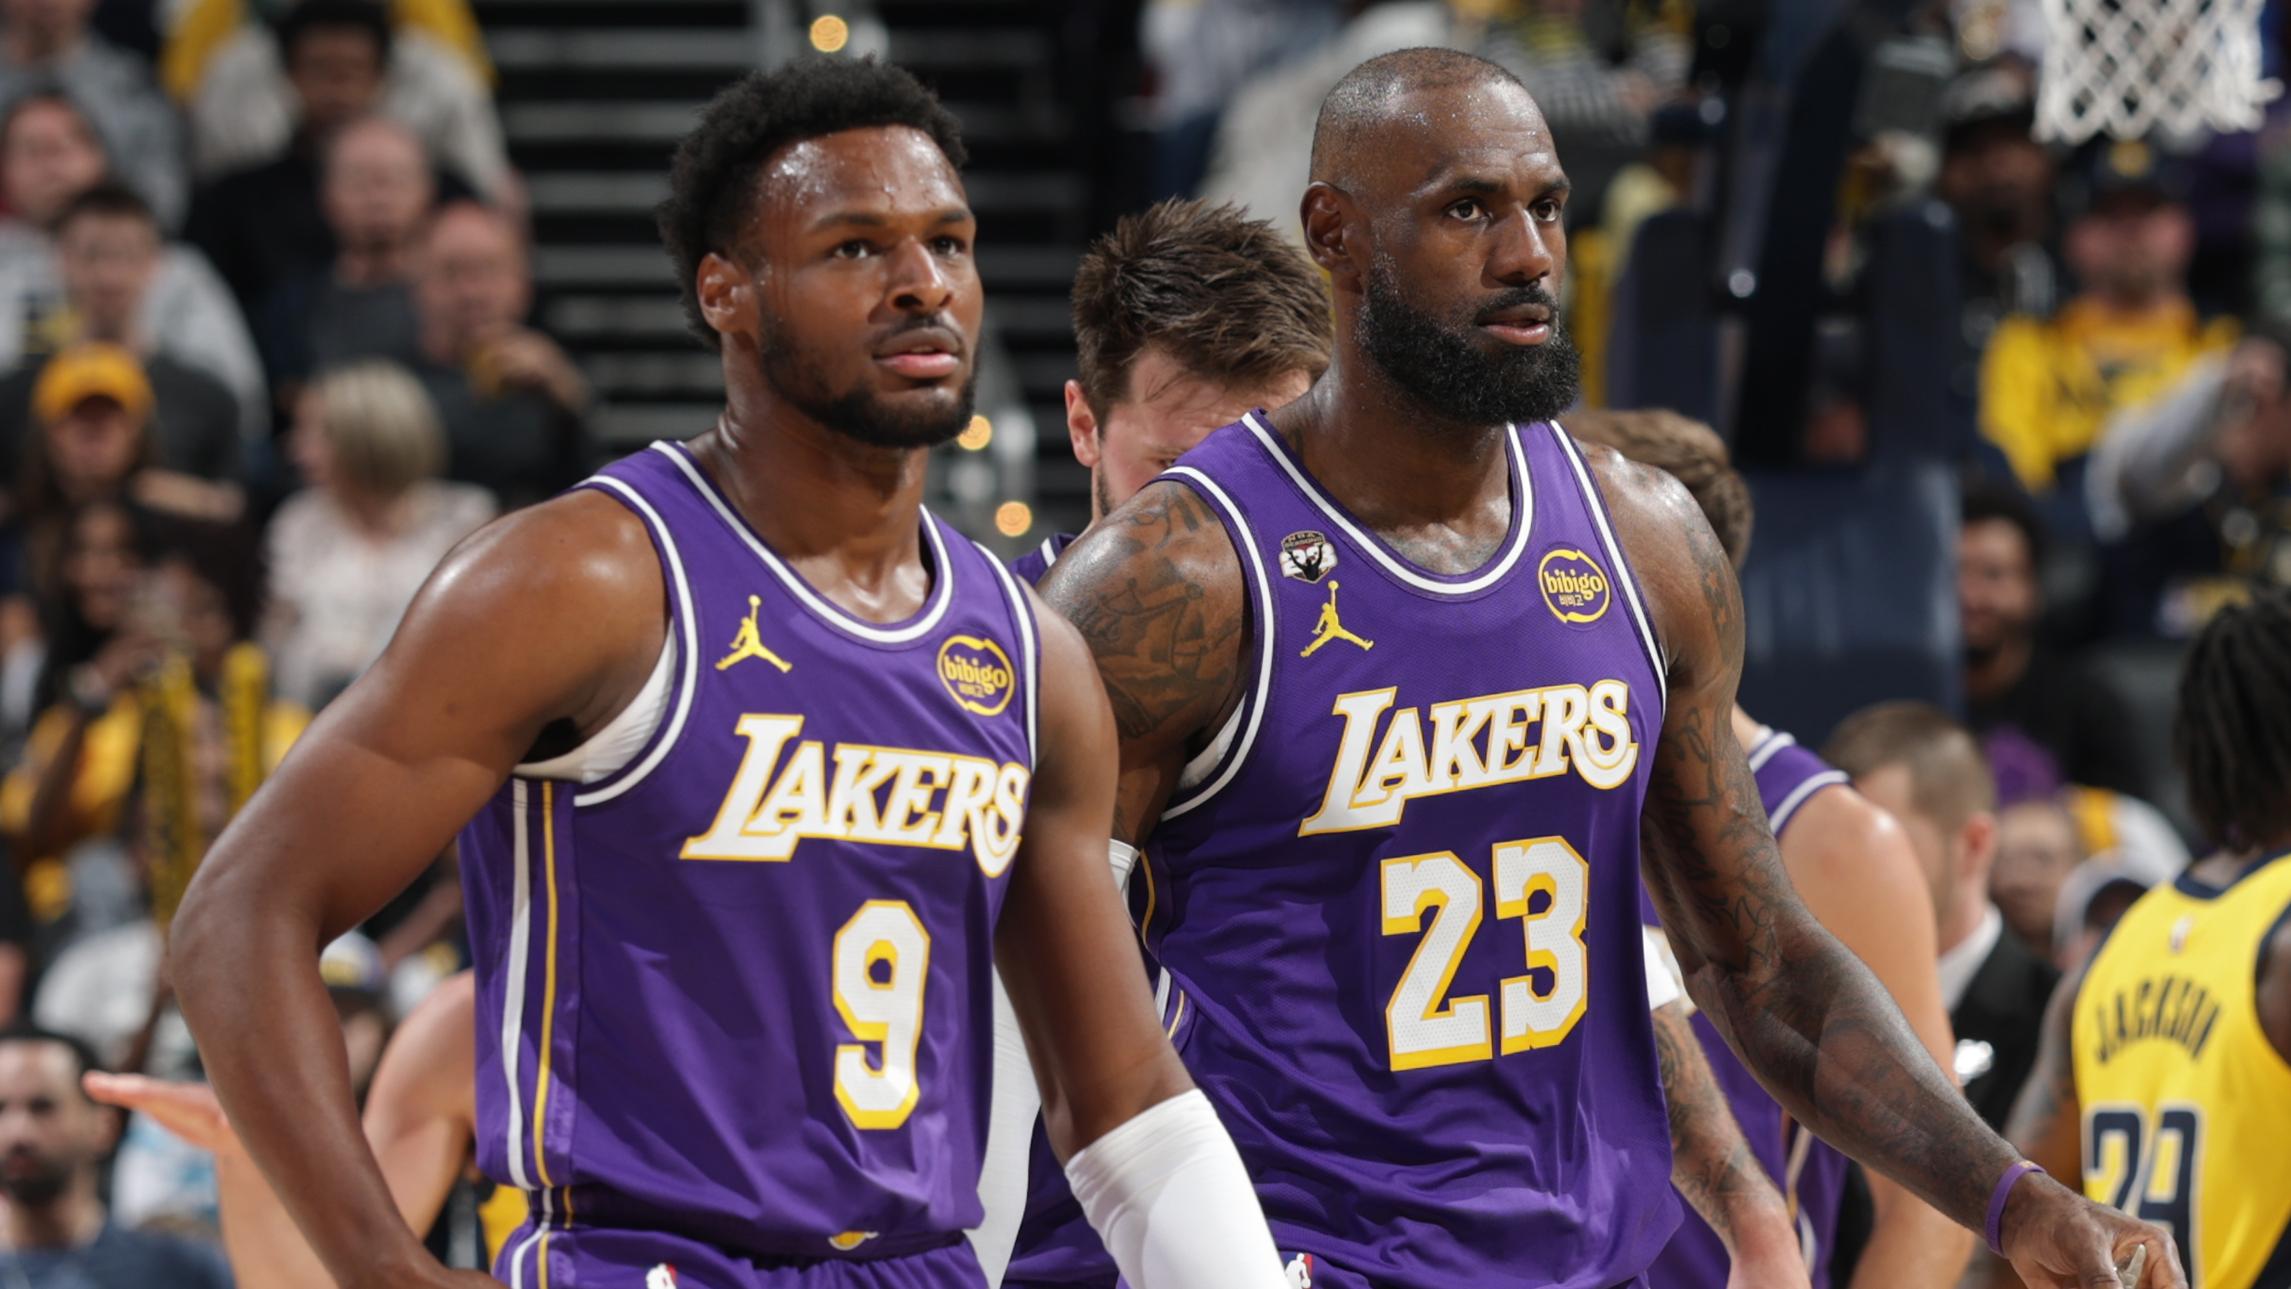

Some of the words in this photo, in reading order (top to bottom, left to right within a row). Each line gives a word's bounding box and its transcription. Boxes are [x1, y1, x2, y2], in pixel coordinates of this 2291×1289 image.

[1543, 568, 1604, 601] bibigo
[943, 654, 1009, 695] bibigo
[679, 713, 1031, 878] LAKERS
[1297, 679, 1640, 838] LAKERS
[832, 899, 931, 1130] 9
[1380, 835, 1589, 1071] 23
[2094, 974, 2222, 1066] JACKSON
